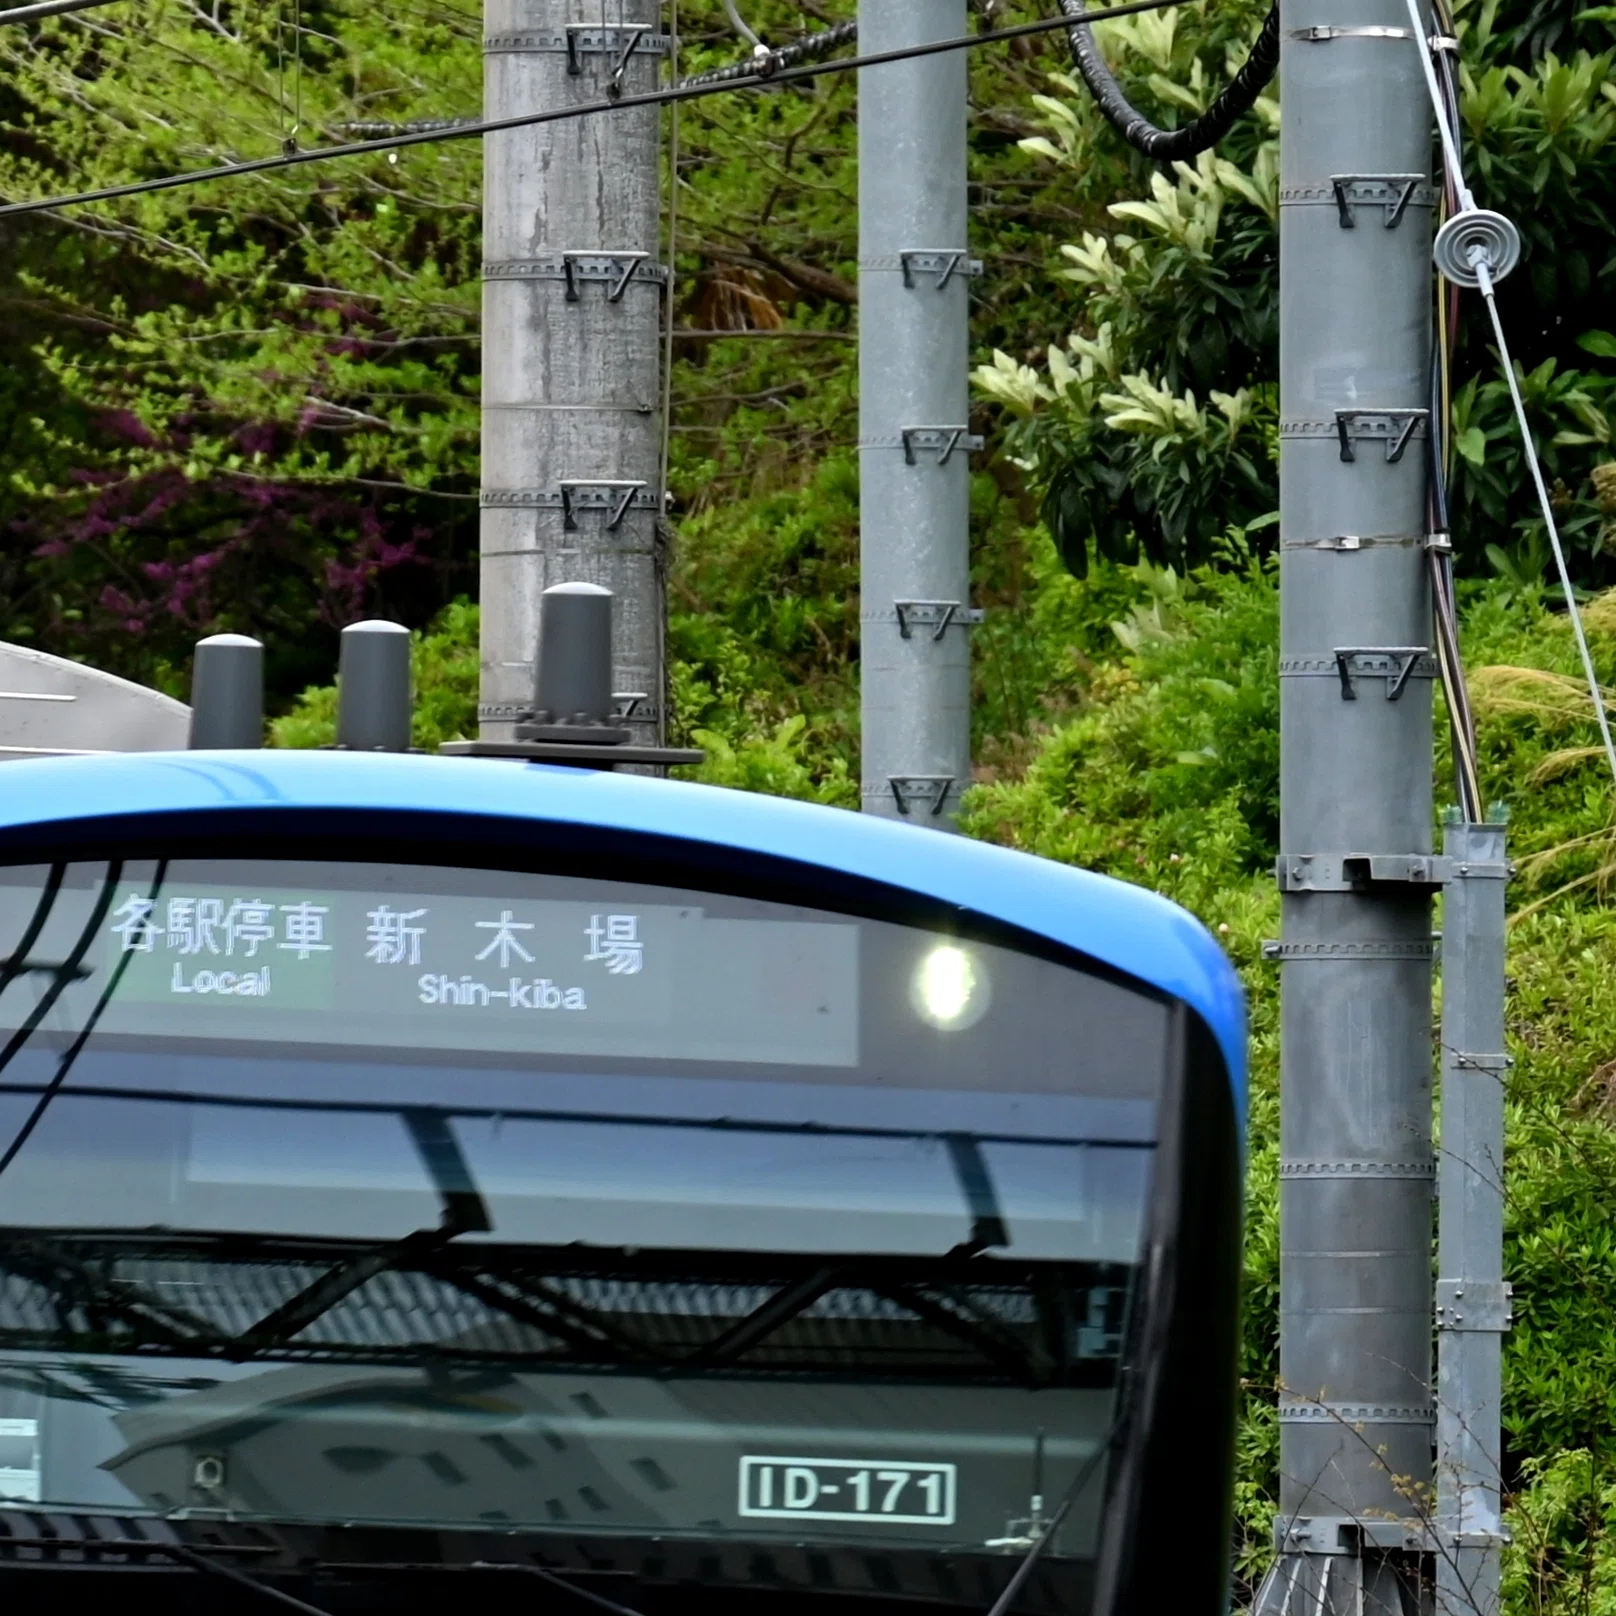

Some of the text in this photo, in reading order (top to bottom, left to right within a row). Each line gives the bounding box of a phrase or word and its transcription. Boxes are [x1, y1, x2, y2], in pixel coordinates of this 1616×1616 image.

[111, 893, 644, 975] 各駅停車 新木場
[171, 961, 588, 1010] Local Shin-kiba
[758, 1466, 941, 1515] ID-171
